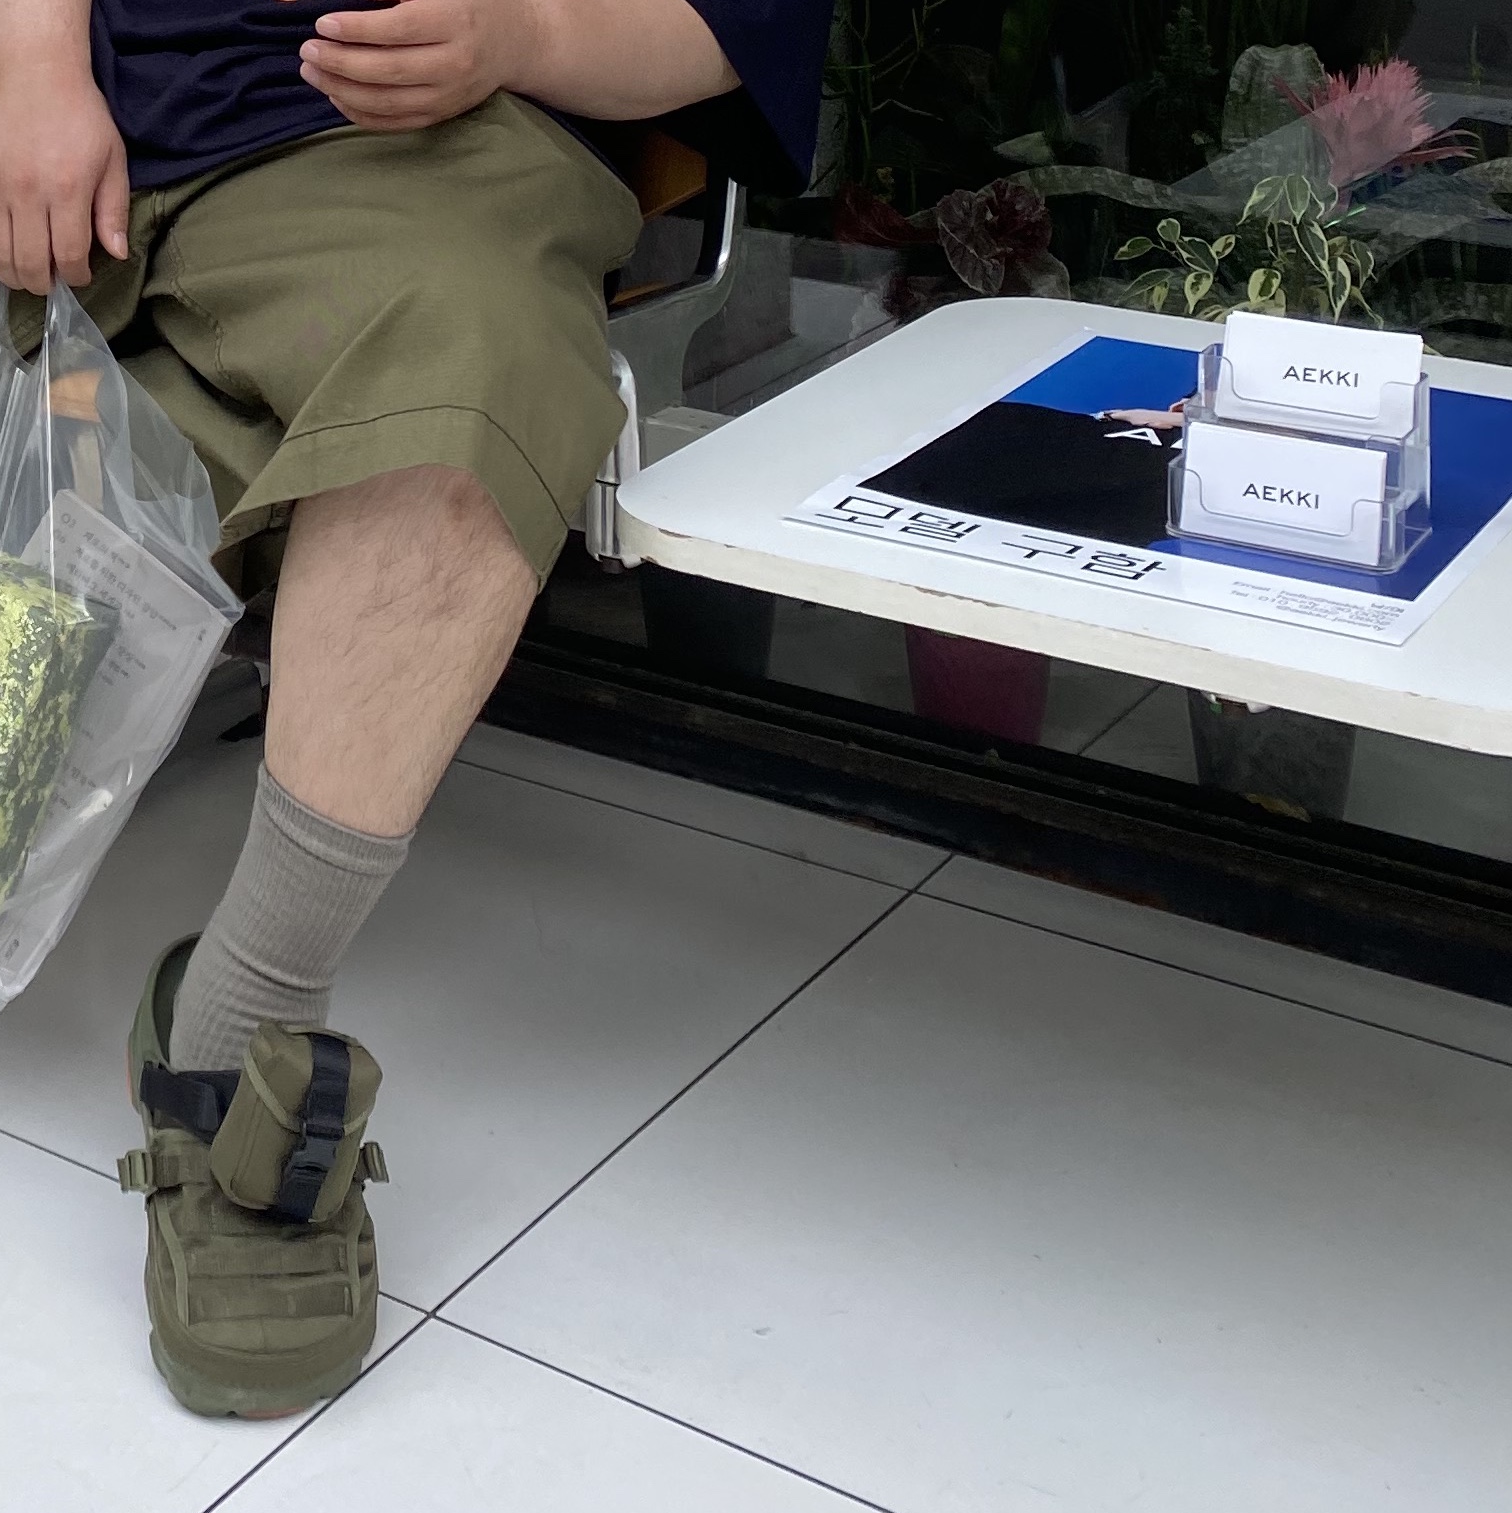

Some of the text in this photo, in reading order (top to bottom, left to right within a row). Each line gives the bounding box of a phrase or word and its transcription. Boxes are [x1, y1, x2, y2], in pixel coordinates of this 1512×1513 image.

[1282, 365, 1359, 388] AEKKI
[1242, 483, 1319, 509] AEKKI
[814, 495, 1167, 580] 모델 구함
